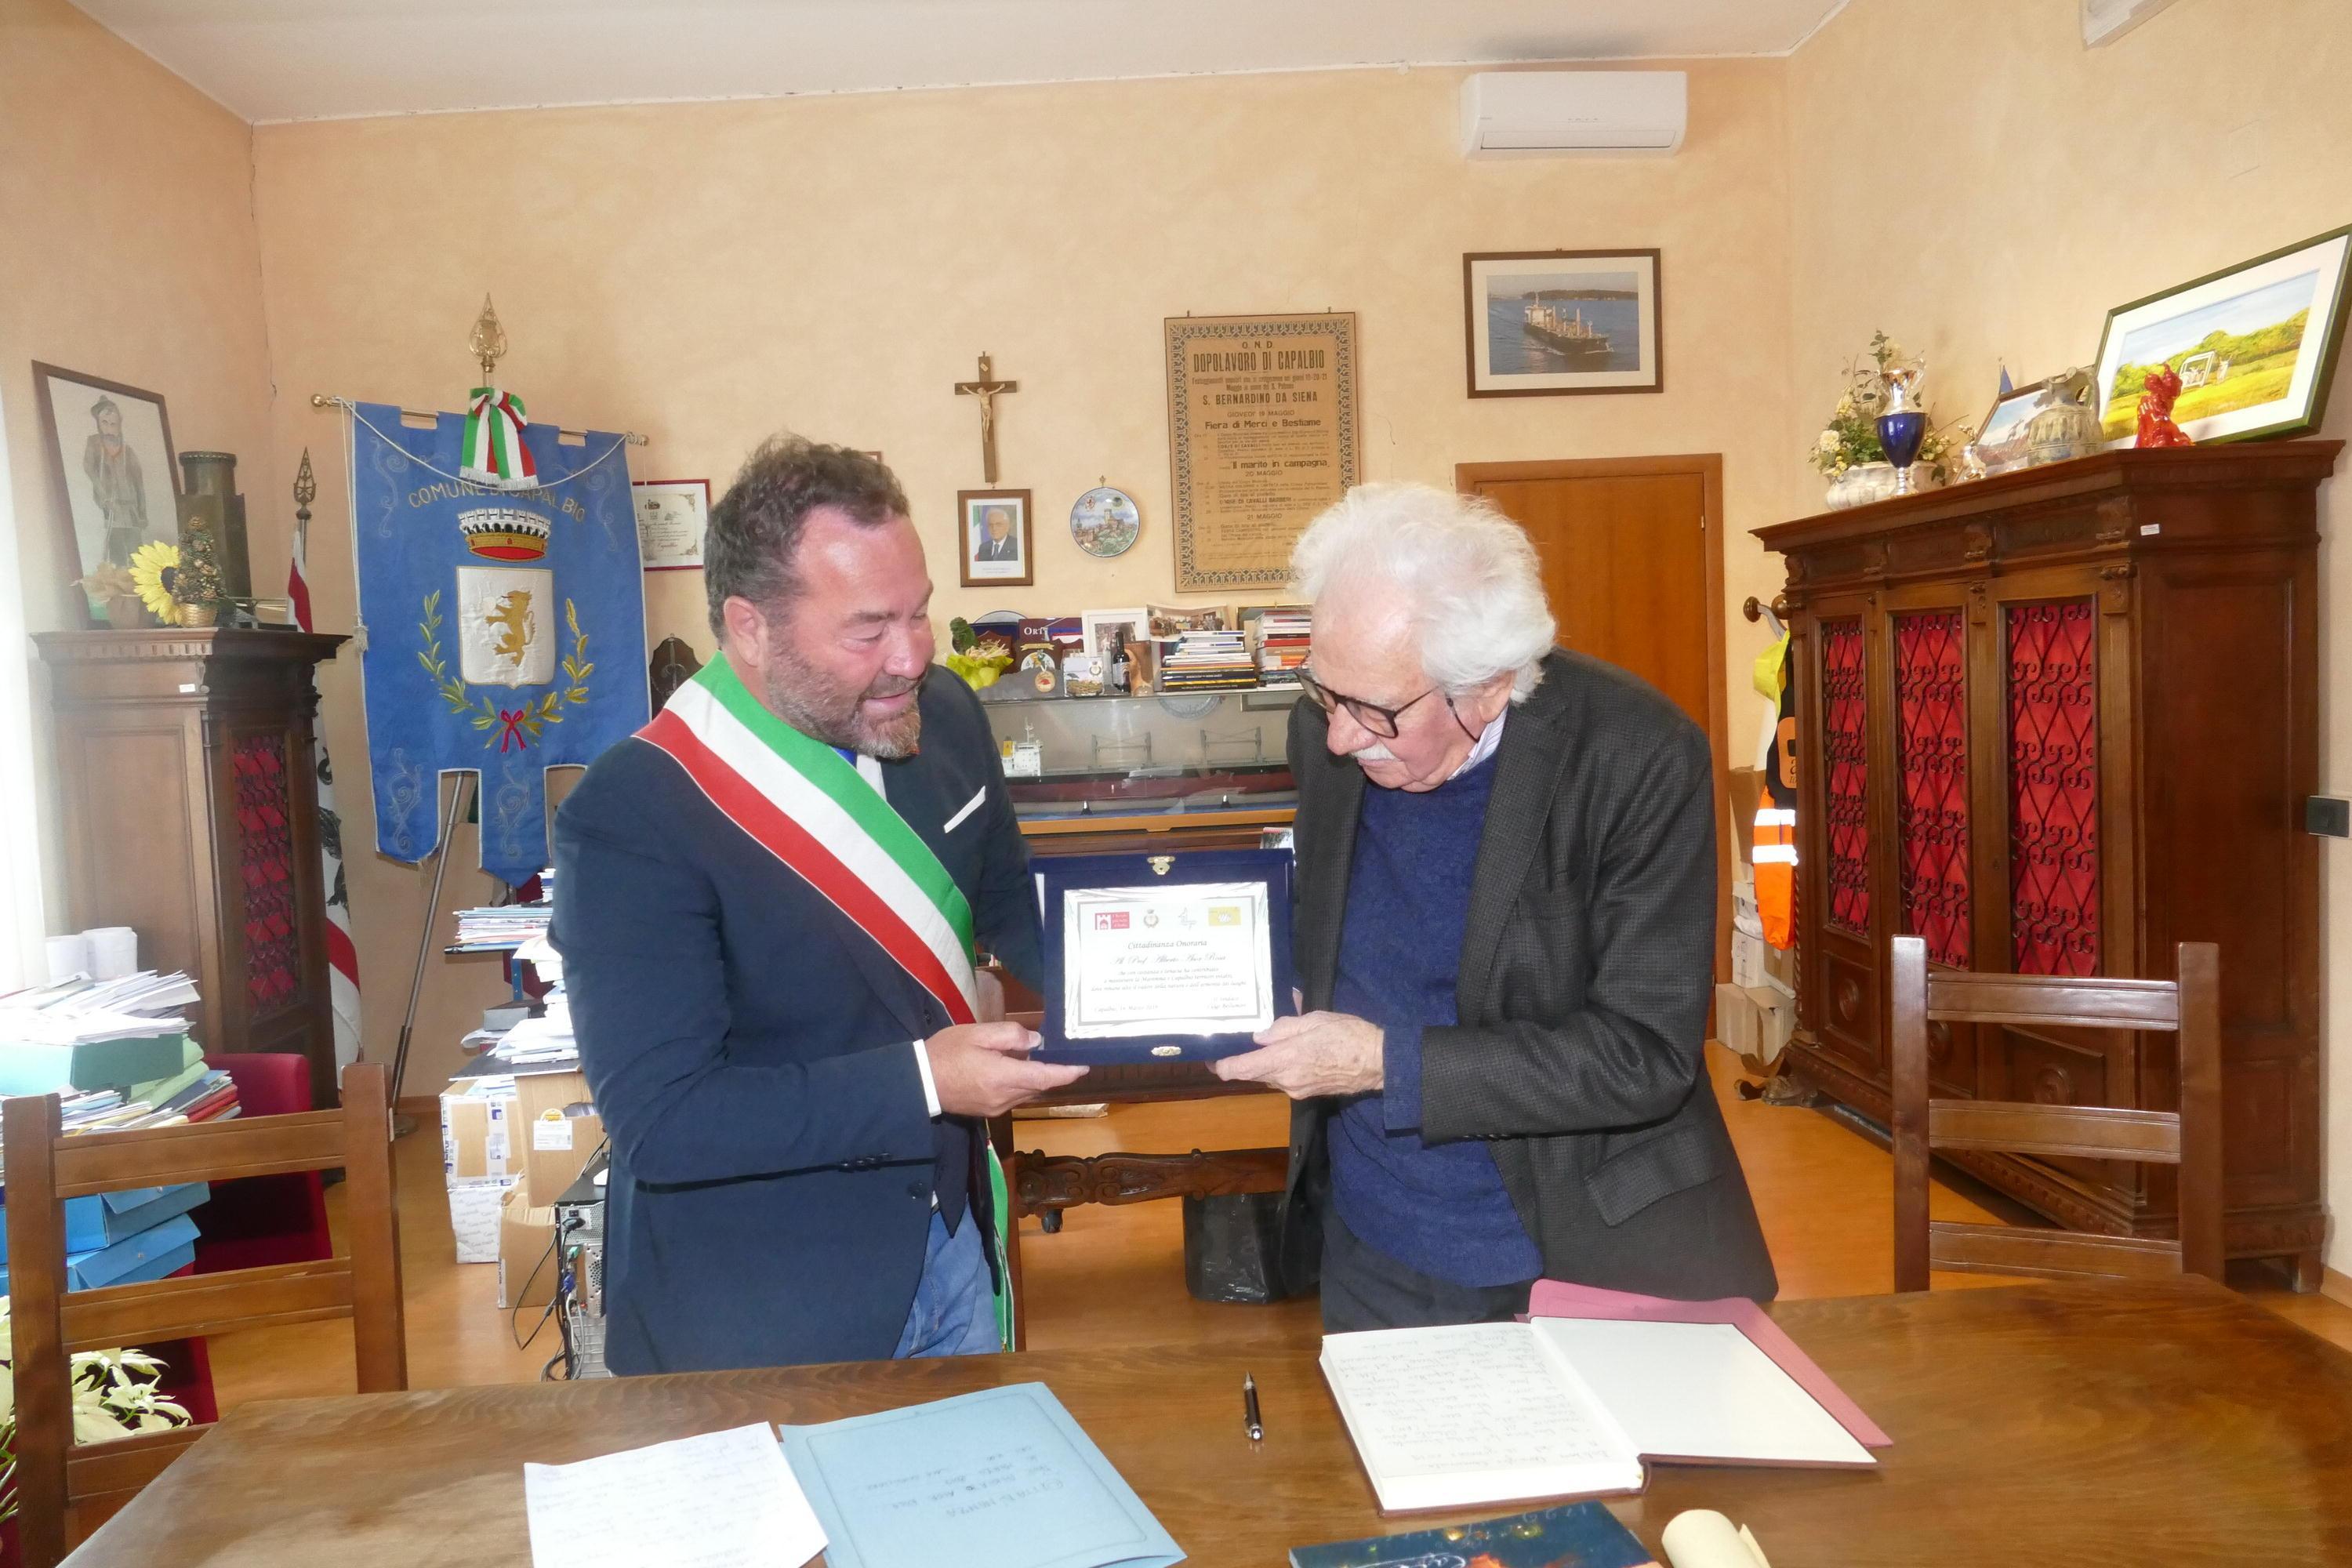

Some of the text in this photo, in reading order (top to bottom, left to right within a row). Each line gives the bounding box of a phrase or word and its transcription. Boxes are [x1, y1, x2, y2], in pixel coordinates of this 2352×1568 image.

[1193, 350, 1325, 372] DOPOLAVORO DI CAPALBIO
[1203, 391, 1318, 406] S. BERNARDINO DA SIENA
[1205, 421, 1229, 430] Fiera
[1232, 420, 1241, 429] di
[1244, 419, 1269, 429] Merci
[1282, 419, 1321, 428] Bestiame
[1240, 460, 1268, 470] marito
[1127, 939, 1207, 950] Cittadinanza Onoraria
